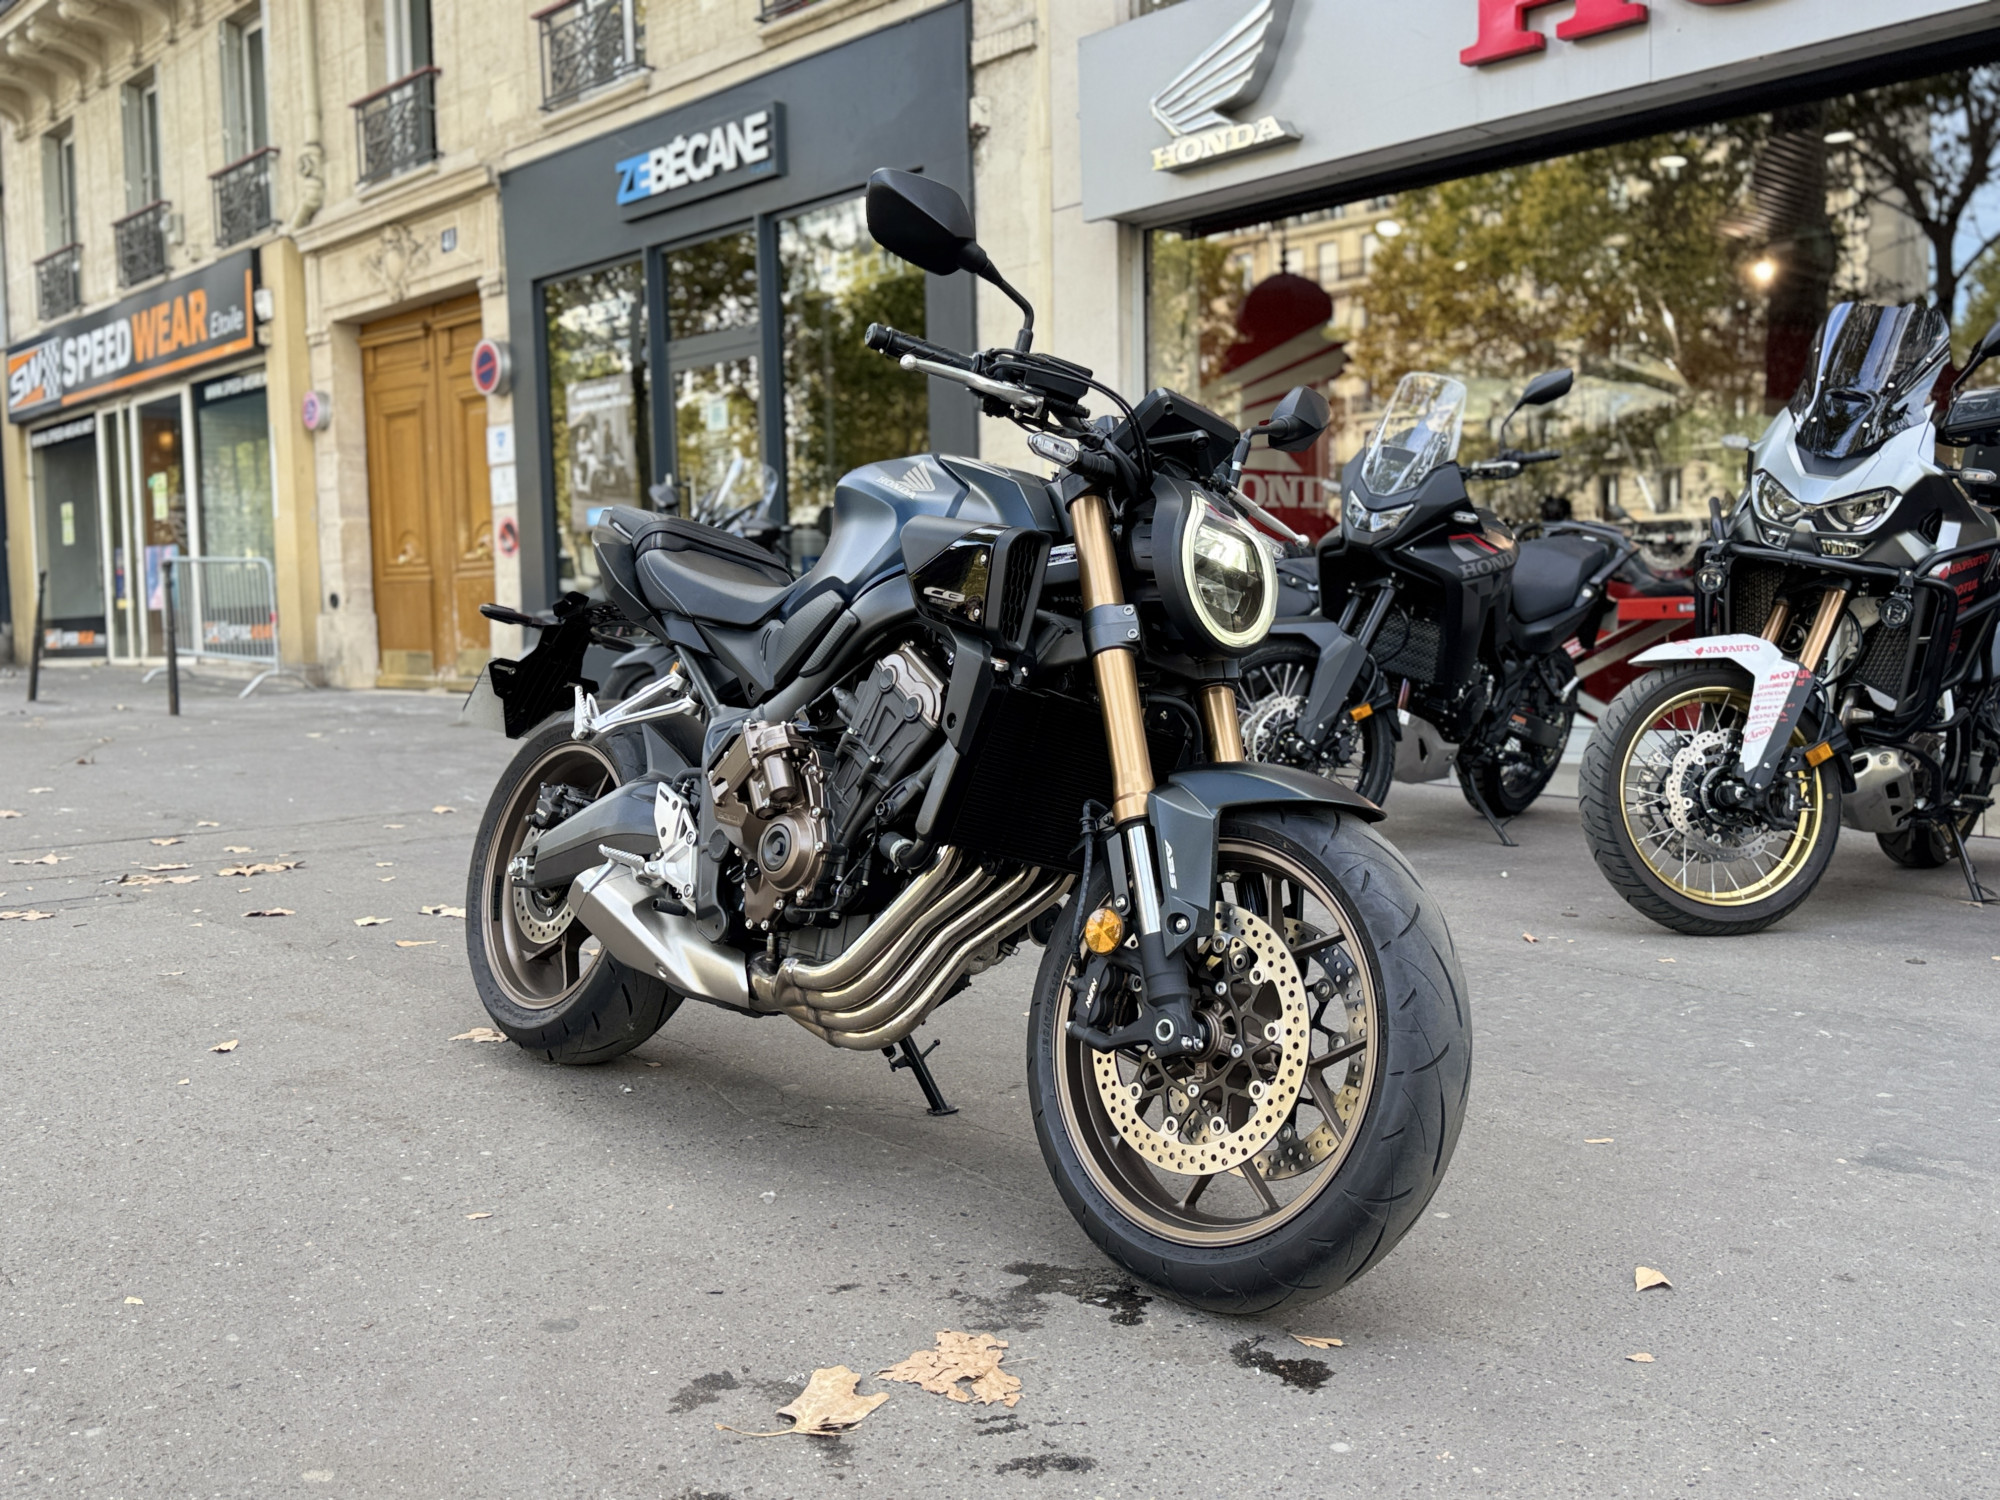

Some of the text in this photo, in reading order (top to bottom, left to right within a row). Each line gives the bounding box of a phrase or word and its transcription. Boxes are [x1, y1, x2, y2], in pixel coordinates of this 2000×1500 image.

[1151, 115, 1286, 170] HONDA
[875, 476, 917, 500] HONDA
[1458, 551, 1514, 579] HOND
[923, 586, 966, 602] CB
[1705, 644, 1760, 654] JAPAUTO
[1769, 669, 1812, 681] MOTUL
[1164, 839, 1178, 890] ABS
